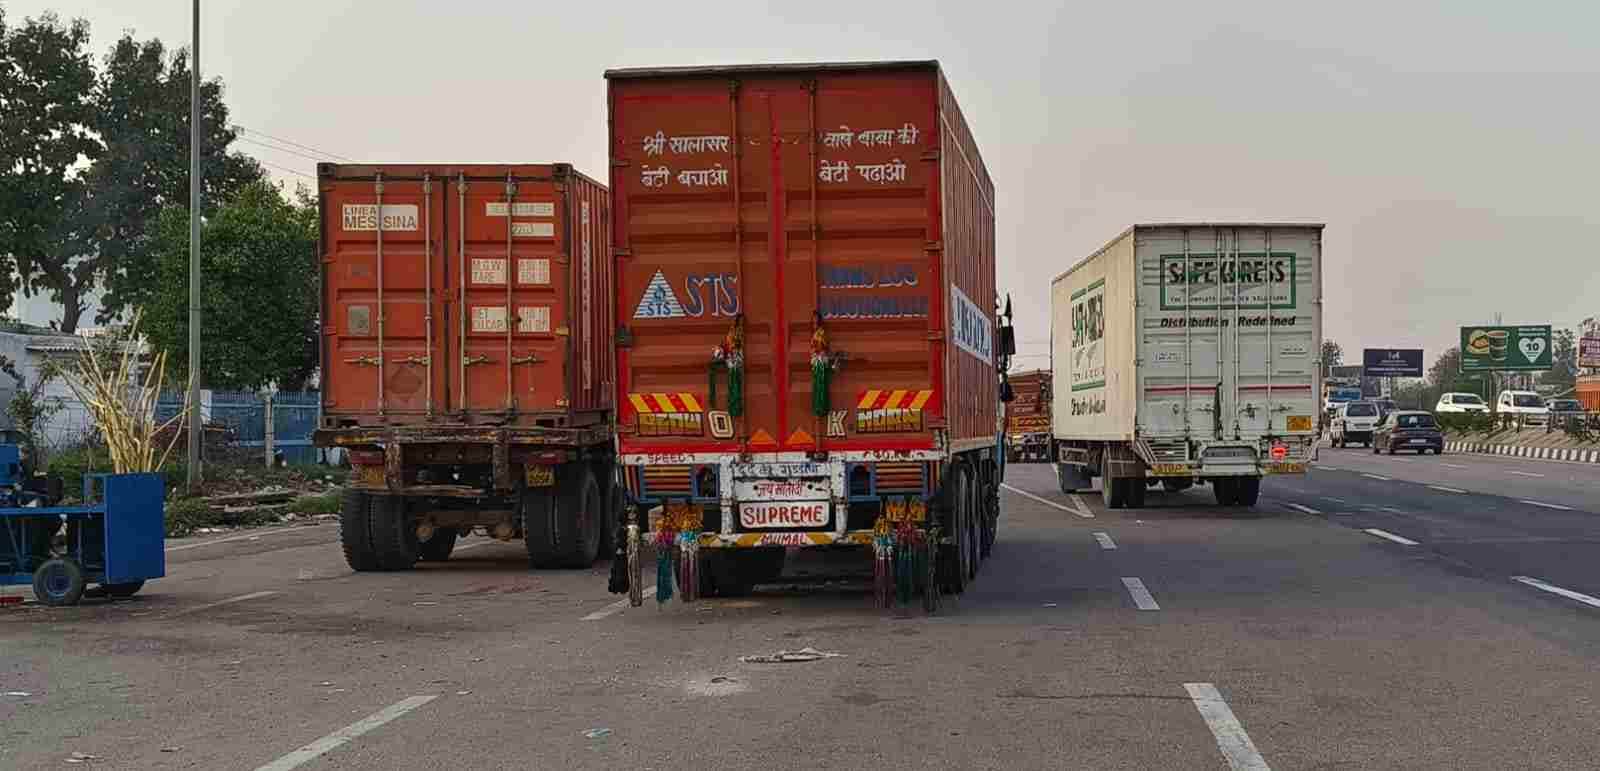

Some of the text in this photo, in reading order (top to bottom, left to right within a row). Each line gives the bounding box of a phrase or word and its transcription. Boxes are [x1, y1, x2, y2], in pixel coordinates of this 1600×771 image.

[345, 215, 417, 228] MESSINA
[683, 273, 741, 318] STS
[647, 303, 672, 317] STS
[1238, 315, 1296, 327] Redeined
[1526, 343, 1540, 351] 10
[827, 410, 848, 437] K
[743, 505, 823, 526] SUPREME
